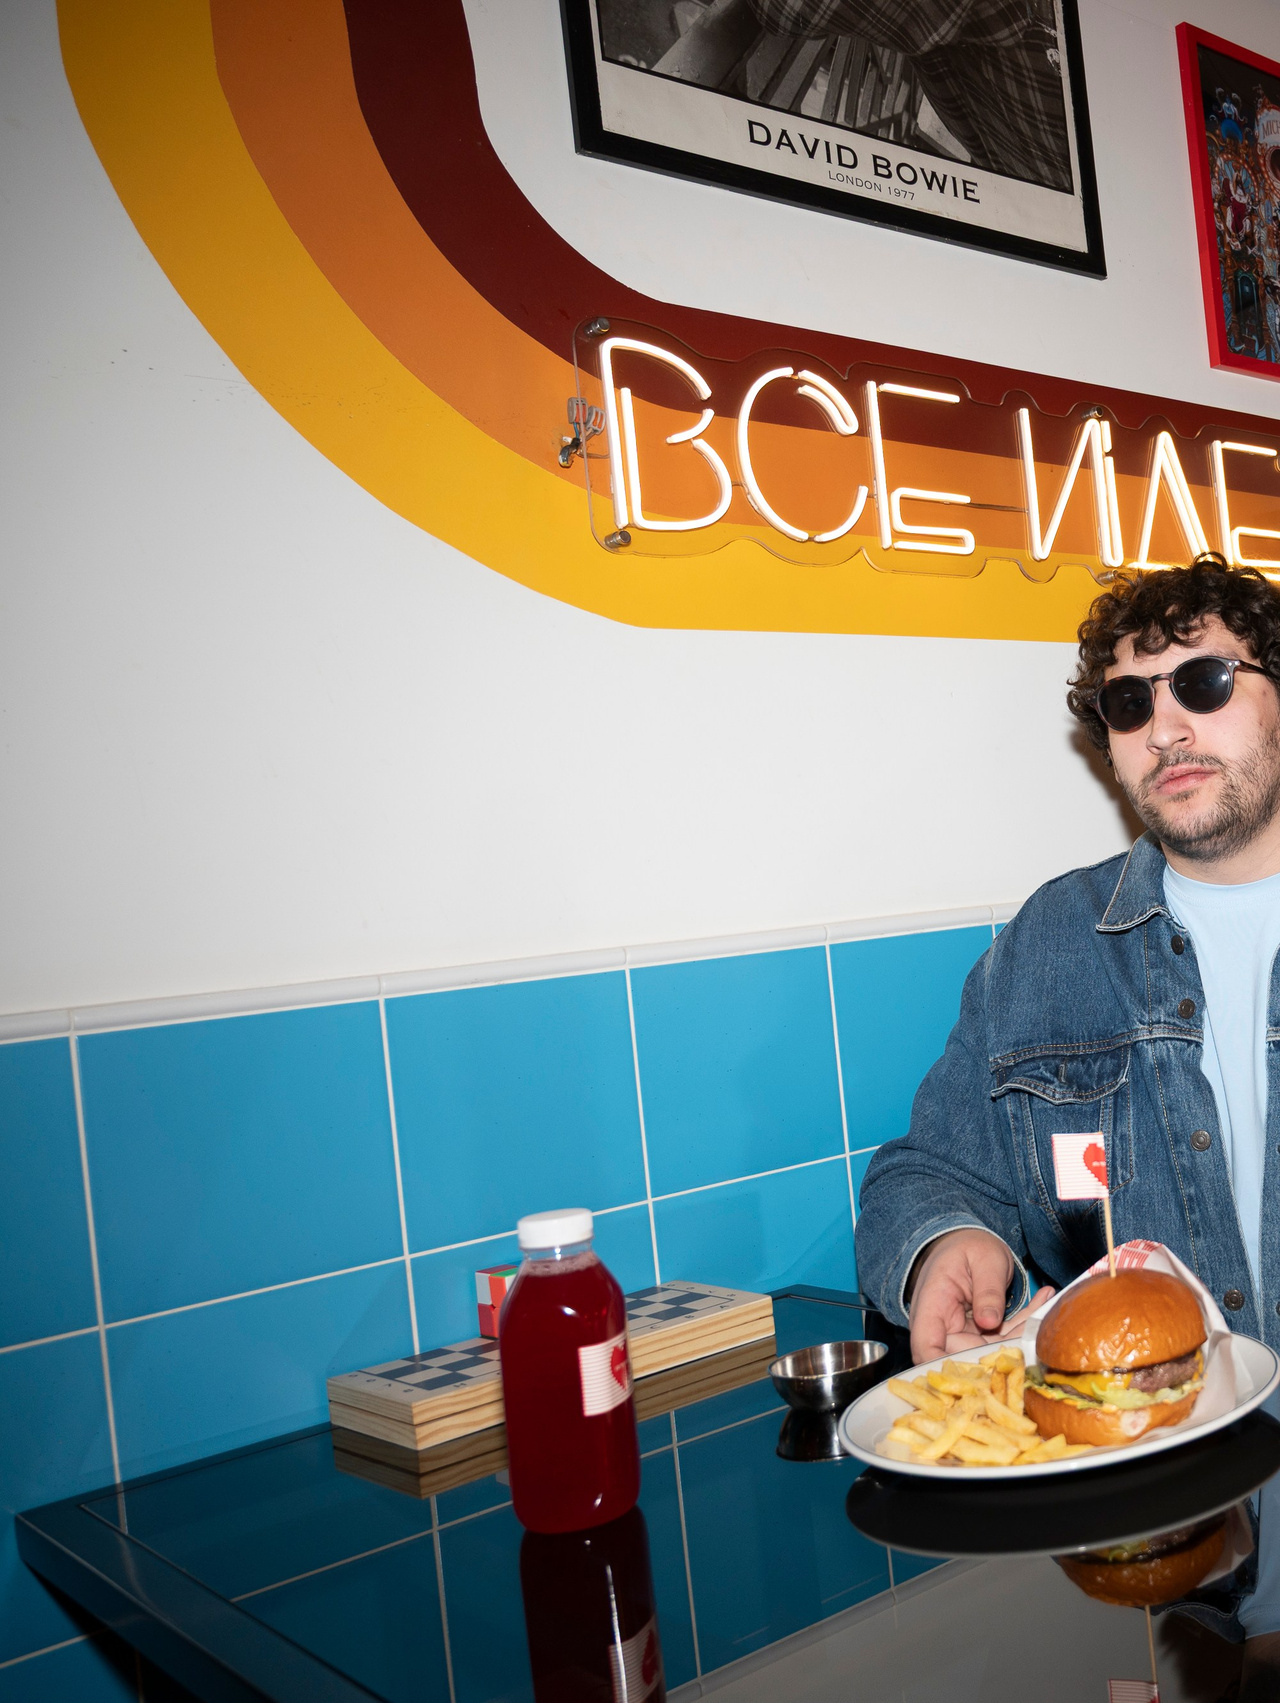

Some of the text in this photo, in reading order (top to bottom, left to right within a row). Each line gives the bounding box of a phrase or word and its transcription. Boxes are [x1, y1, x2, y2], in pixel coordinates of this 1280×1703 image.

[746, 119, 981, 204] DAVID BOWIE
[828, 170, 915, 201] LONDON 1977
[600, 336, 977, 556] ВСЕ
